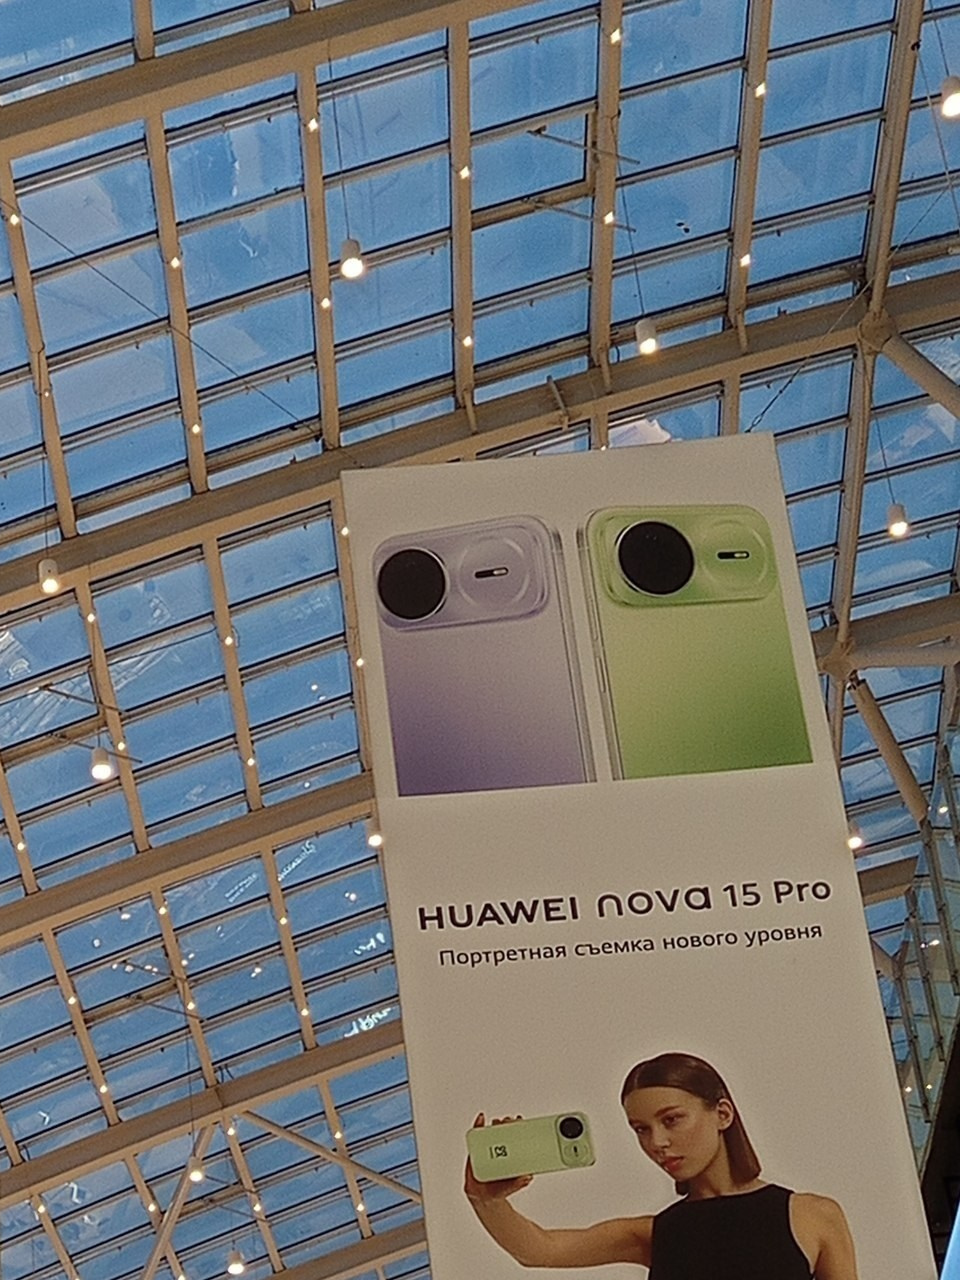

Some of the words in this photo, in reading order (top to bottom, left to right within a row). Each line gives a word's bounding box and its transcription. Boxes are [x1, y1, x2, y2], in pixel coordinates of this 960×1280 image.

[418, 896, 578, 930] HUAWEI
[597, 886, 711, 918] nova
[723, 883, 761, 907] 15
[773, 880, 831, 903] Pro
[440, 942, 566, 967] Портретная
[575, 937, 654, 957] съемка
[663, 930, 738, 950] нового
[745, 924, 821, 948] уровня
